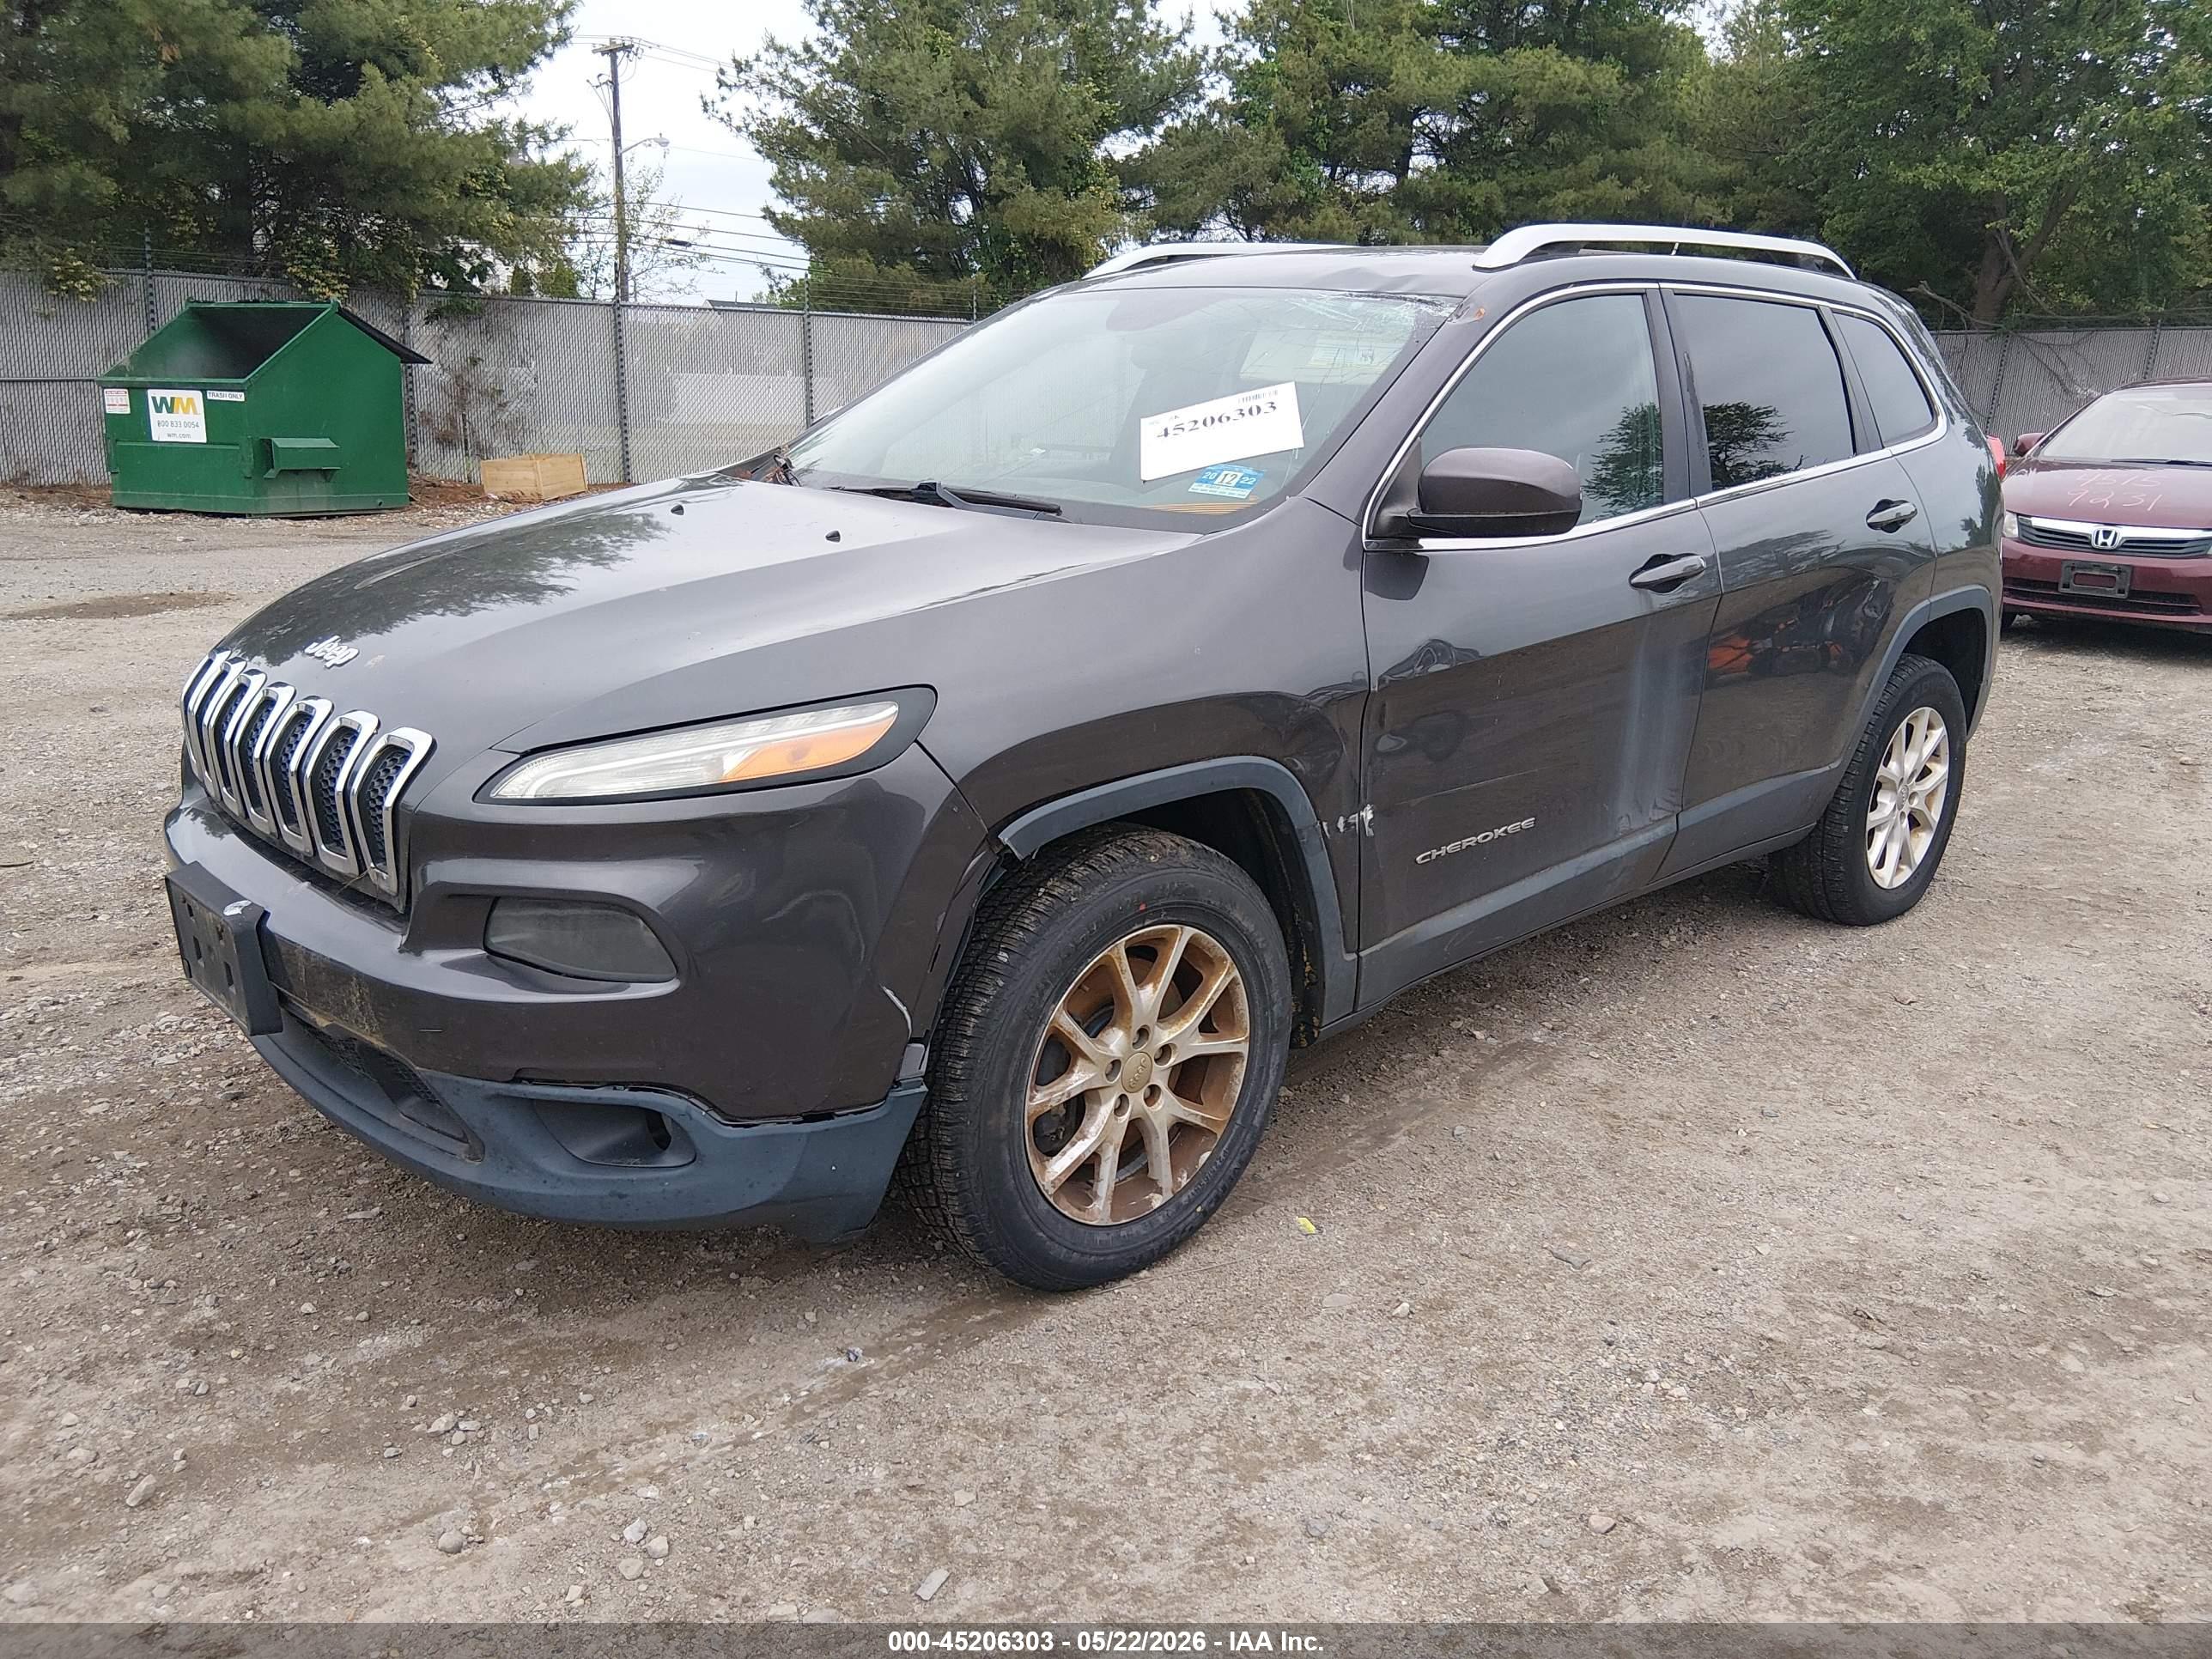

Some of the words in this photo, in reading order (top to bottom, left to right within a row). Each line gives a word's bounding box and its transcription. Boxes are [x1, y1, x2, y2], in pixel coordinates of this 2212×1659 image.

[151, 396, 200, 415] WM
[157, 419, 169, 428] 800
[1157, 401, 1277, 438] 45206303
[1202, 471, 1218, 480] 20
[1219, 473, 1237, 485] 12
[1239, 476, 1257, 484] 22
[2068, 489, 2163, 511] 9231
[304, 635, 359, 668] Jeep
[1416, 817, 1535, 865] CHEROKEE
